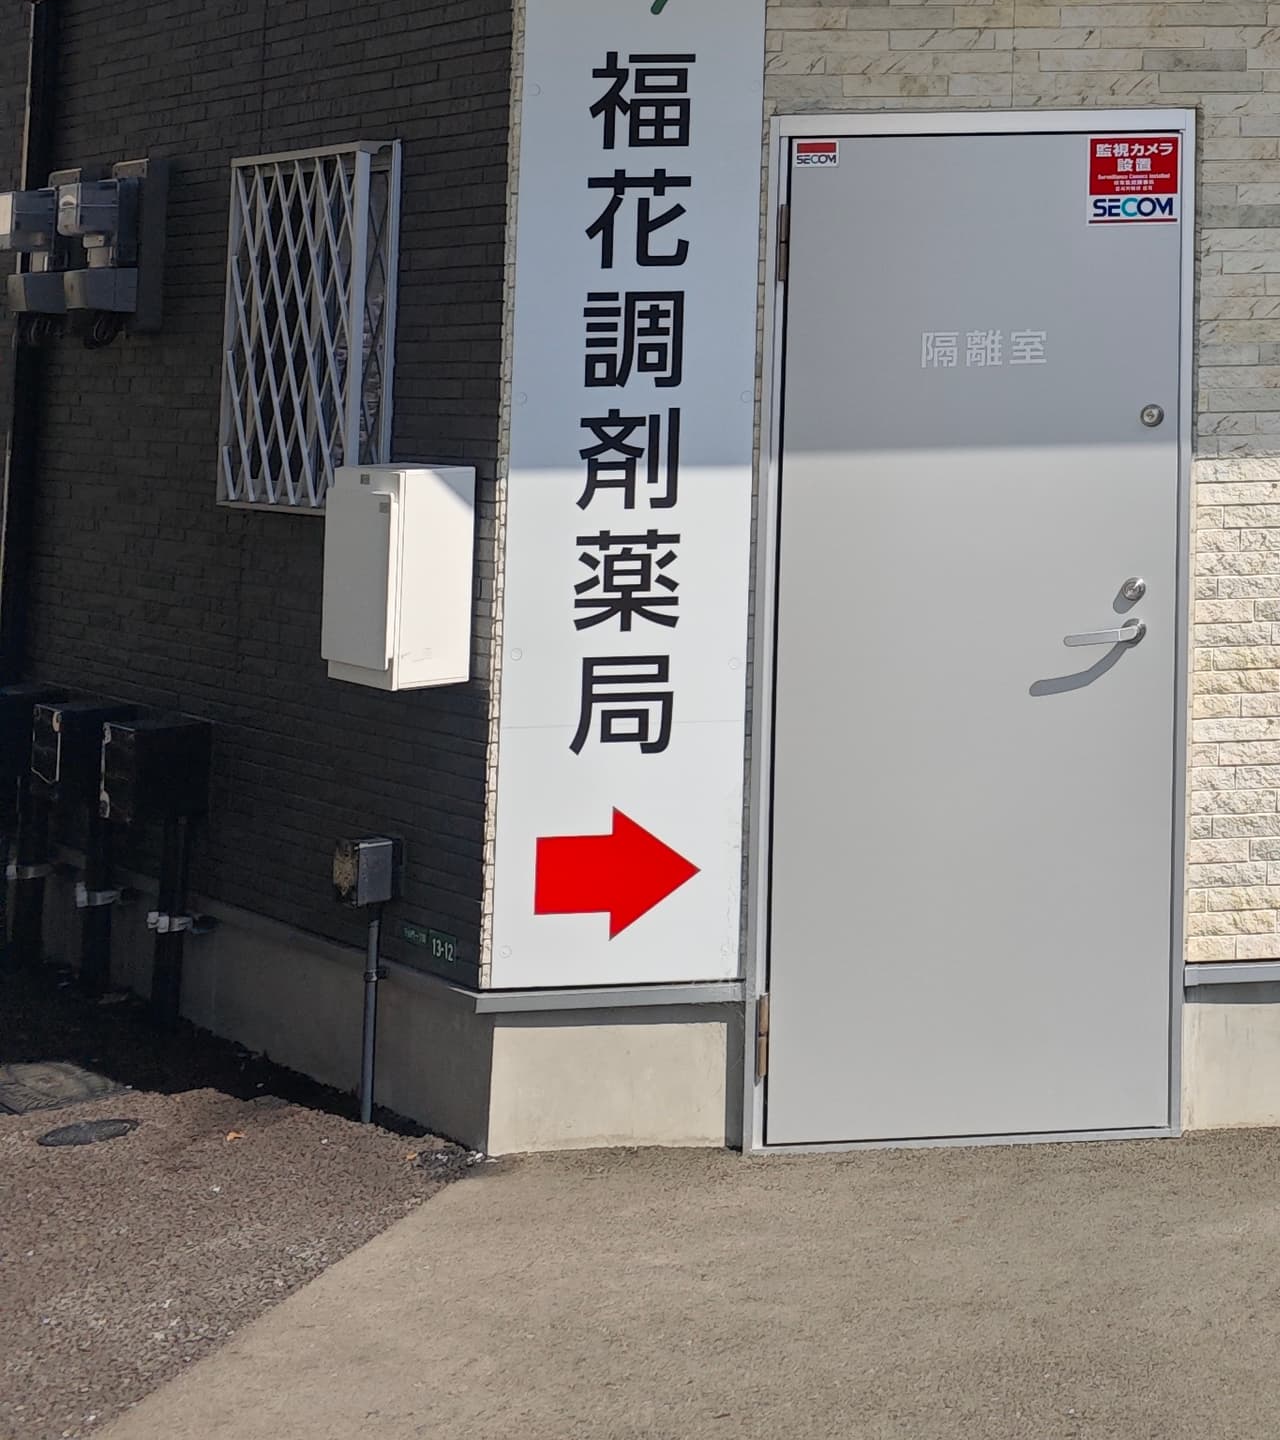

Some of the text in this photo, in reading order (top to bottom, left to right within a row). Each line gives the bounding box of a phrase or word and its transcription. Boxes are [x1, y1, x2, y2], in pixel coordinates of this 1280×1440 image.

[796, 153, 837, 165] SECOM
[1095, 143, 1174, 158] 監視カメラ
[1117, 158, 1152, 172] 設置
[1093, 197, 1174, 217] SECOM
[921, 329, 1048, 369] 隔離室
[569, 51, 697, 756] 福花調剤薬局
[432, 938, 454, 962] 13-12
